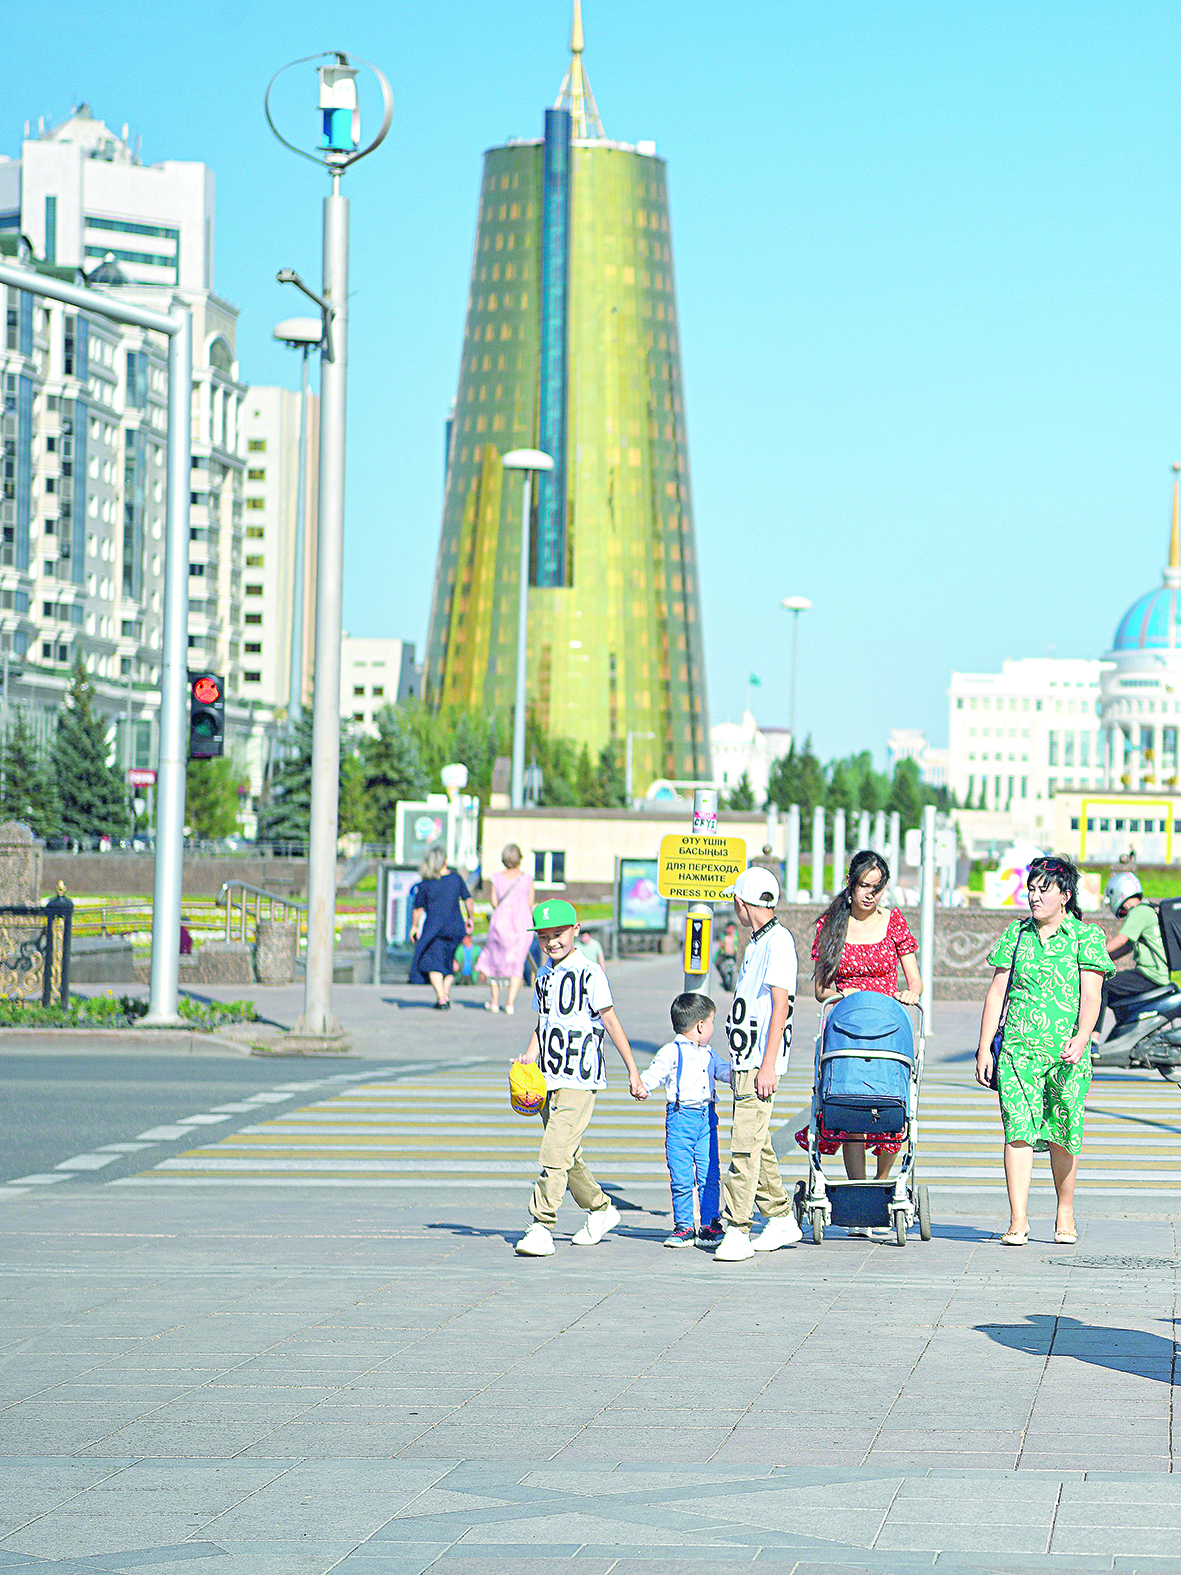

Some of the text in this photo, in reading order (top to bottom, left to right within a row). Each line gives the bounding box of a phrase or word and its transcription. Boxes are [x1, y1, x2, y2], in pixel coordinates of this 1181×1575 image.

[682, 836, 727, 847] ӨТУ ҮШІН
[679, 847, 729, 857] БАСЫҢЫЗ
[665, 862, 740, 873] ДЛЯ ПЕРЕХОДА
[678, 873, 726, 882] НАЖМИТЕ
[669, 888, 701, 897] PRESS
[704, 889, 717, 898] TO
